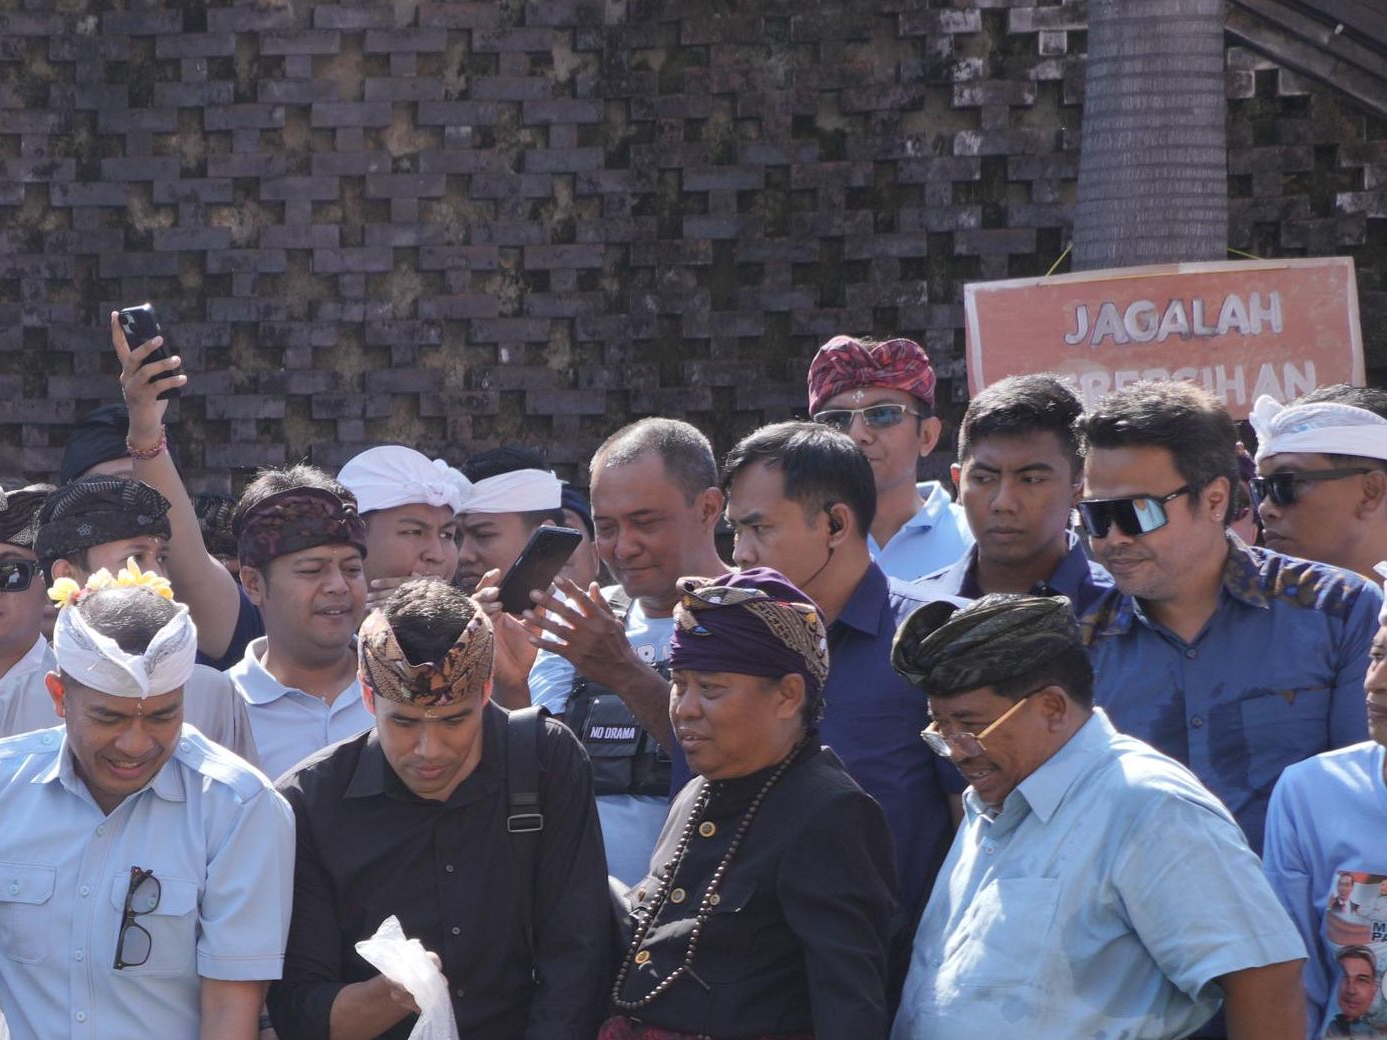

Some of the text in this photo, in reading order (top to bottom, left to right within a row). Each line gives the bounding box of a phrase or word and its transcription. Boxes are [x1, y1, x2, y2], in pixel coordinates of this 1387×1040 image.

[1065, 292, 1283, 345] JAGALAH
[590, 726, 636, 739] NO DRAMA
